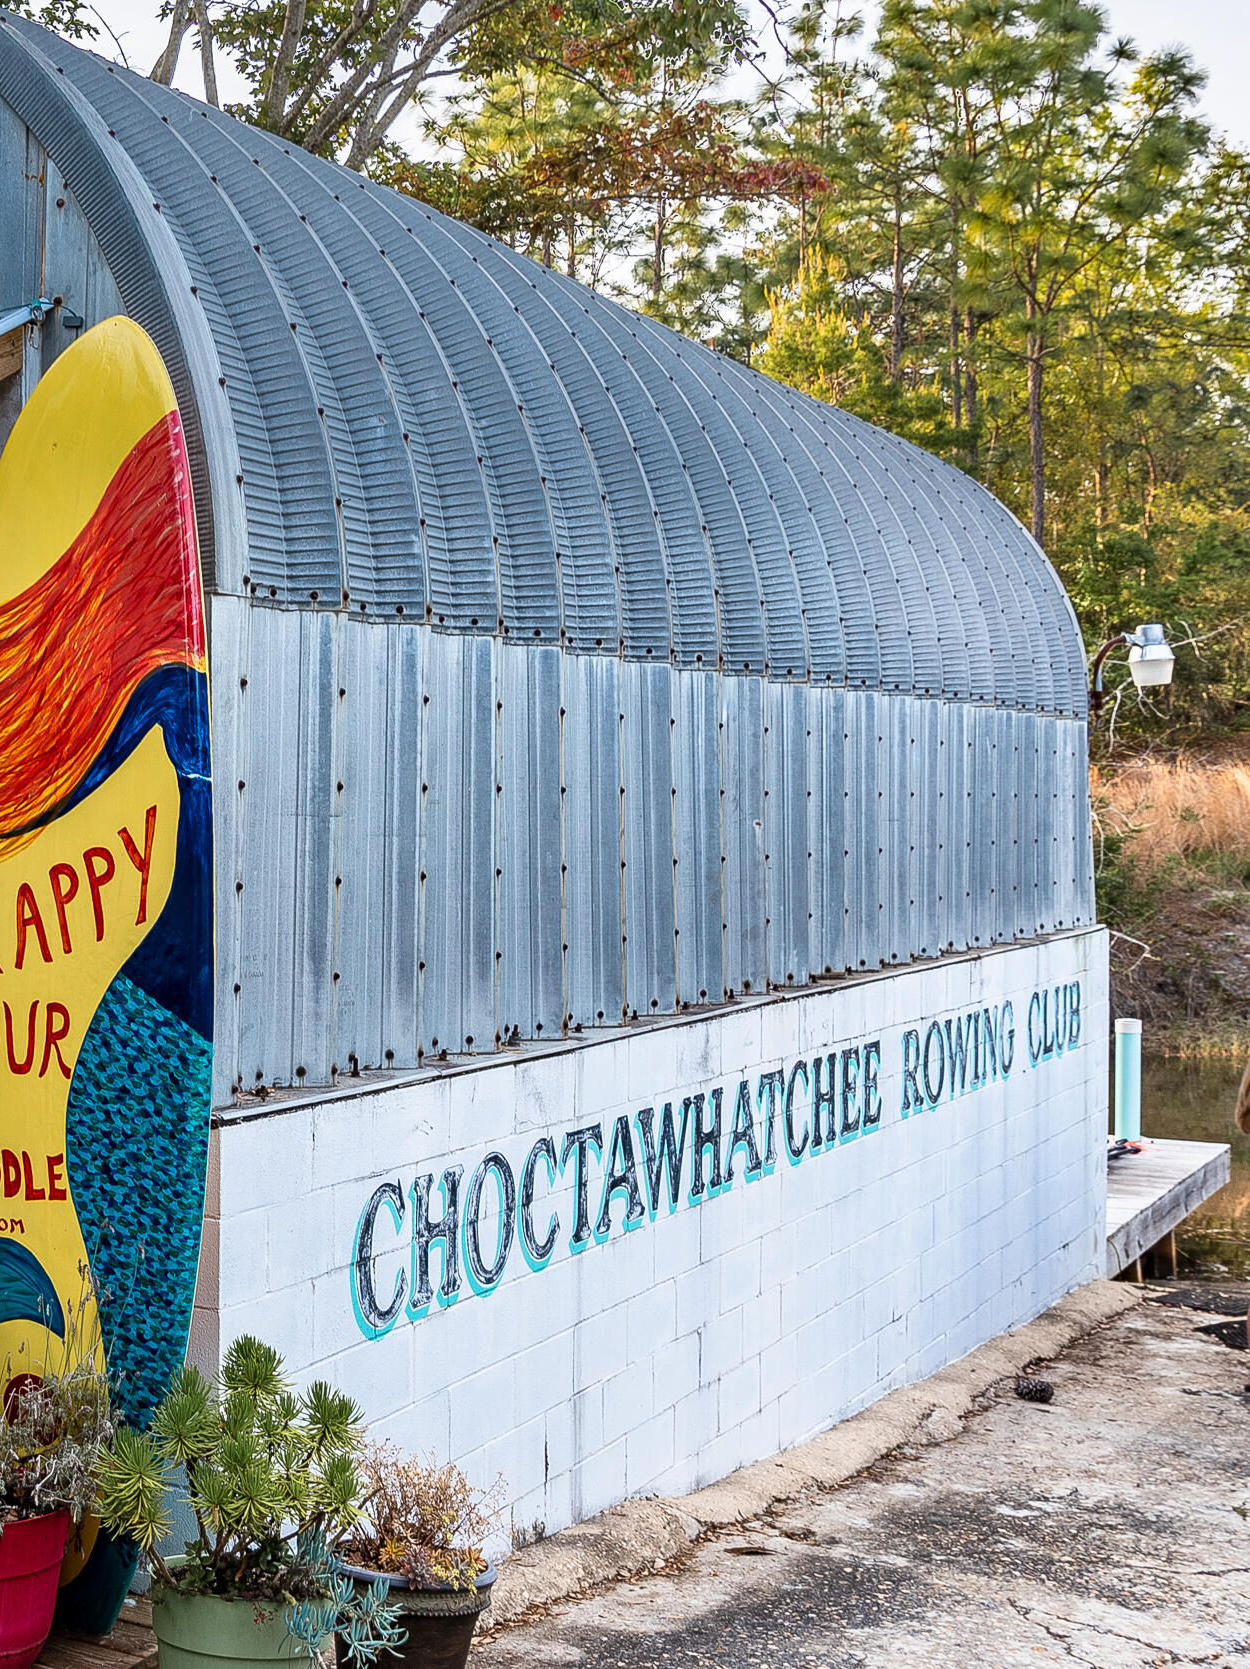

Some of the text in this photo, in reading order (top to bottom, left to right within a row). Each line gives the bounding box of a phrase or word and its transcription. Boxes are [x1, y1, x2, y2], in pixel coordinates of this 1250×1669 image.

[350, 980, 1082, 1341] CHOCTAWHATCHEE ROWING CLUB
